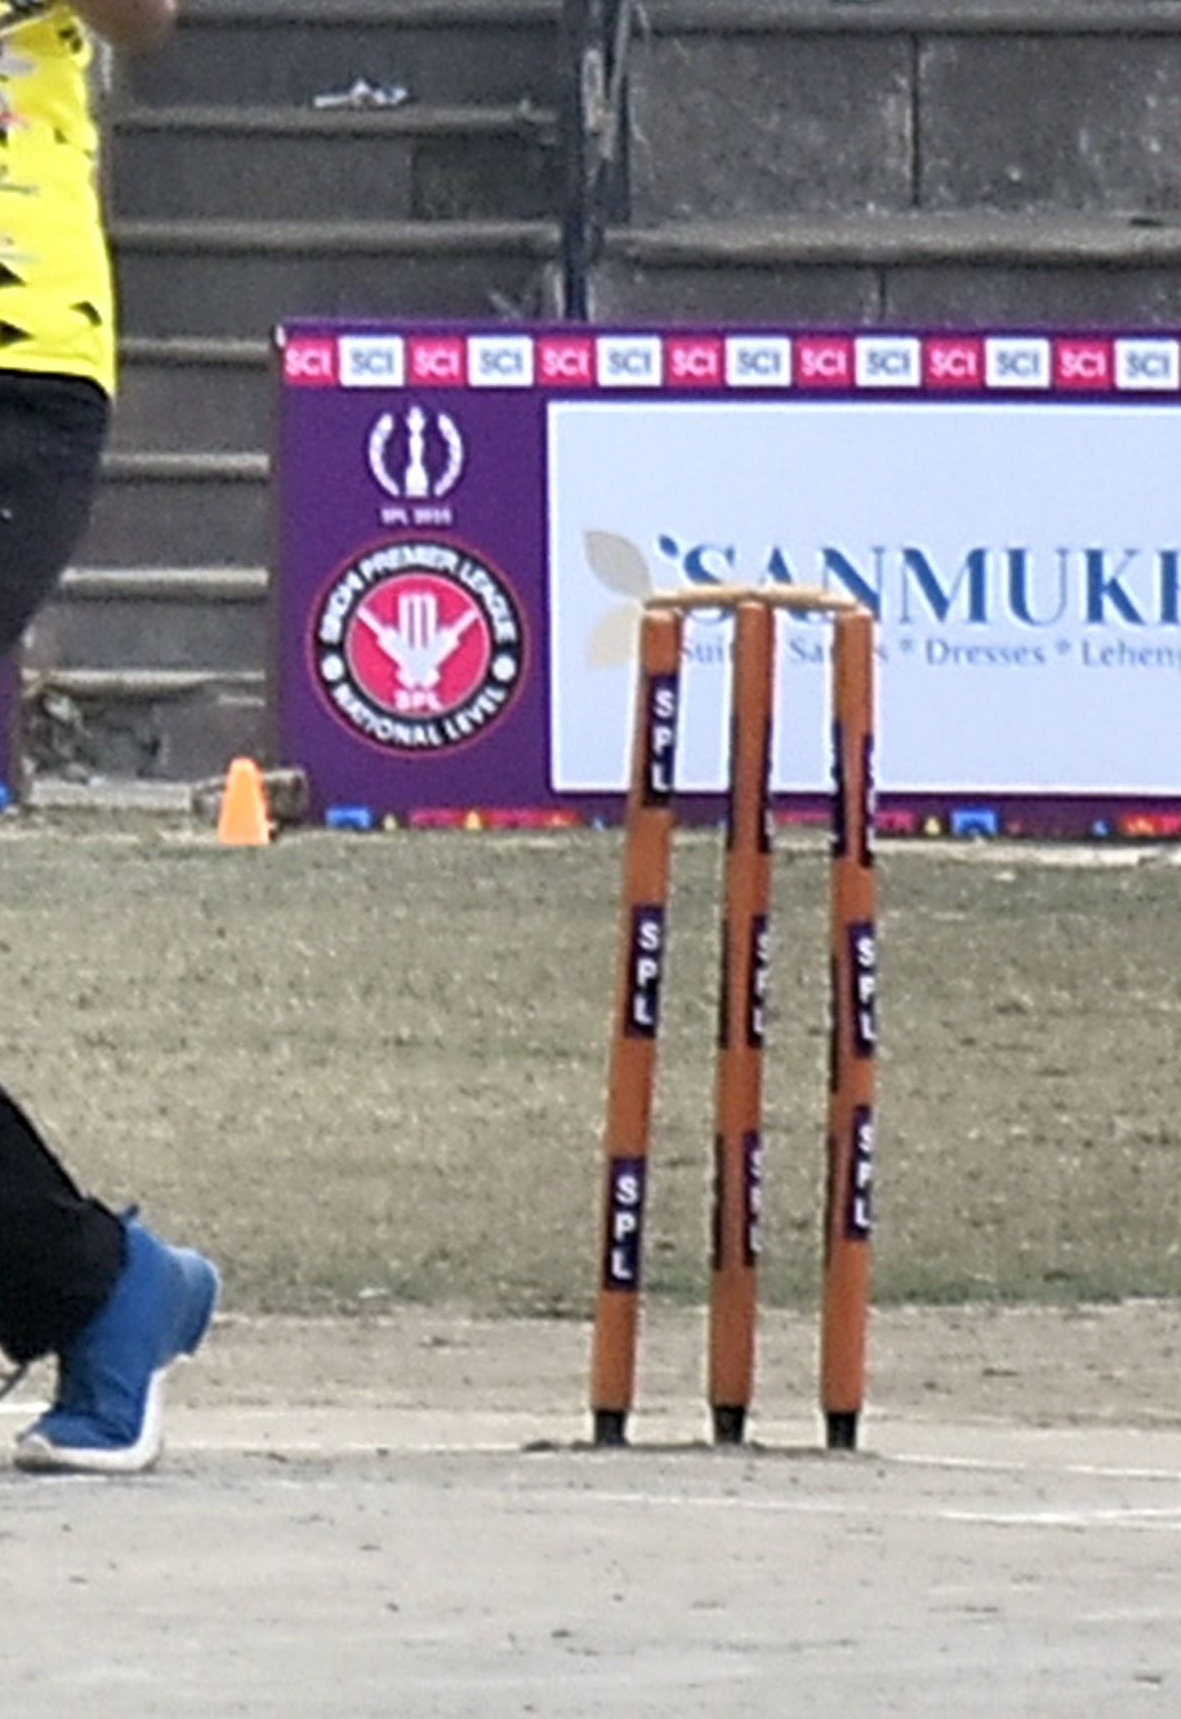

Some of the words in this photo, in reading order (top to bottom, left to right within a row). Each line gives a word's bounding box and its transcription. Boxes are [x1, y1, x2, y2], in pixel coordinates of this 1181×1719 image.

[285, 348, 331, 375] SCI
[351, 349, 393, 374] SCI
[415, 348, 459, 375] SCI
[480, 349, 523, 374] SCI
[543, 348, 588, 375] SCI
[608, 349, 652, 375] SCI
[672, 349, 717, 375] SCI
[736, 350, 781, 374] SCI
[800, 349, 847, 376] SCI
[867, 350, 910, 375] SCI
[930, 349, 976, 376] SCI
[996, 351, 1039, 376] SCI
[1060, 350, 1106, 376] SCI
[1126, 351, 1170, 377] SCI
[359, 544, 460, 581] PREMIER
[459, 562, 517, 643] LEAGUE
[926, 639, 1046, 665] Dresses
[332, 683, 443, 747] NATIONAL
[444, 687, 508, 741] LEVEL
[651, 689, 674, 791] SPL
[633, 922, 661, 1025] SPL
[857, 937, 875, 1042] SPL
[612, 1175, 639, 1280] SPL
